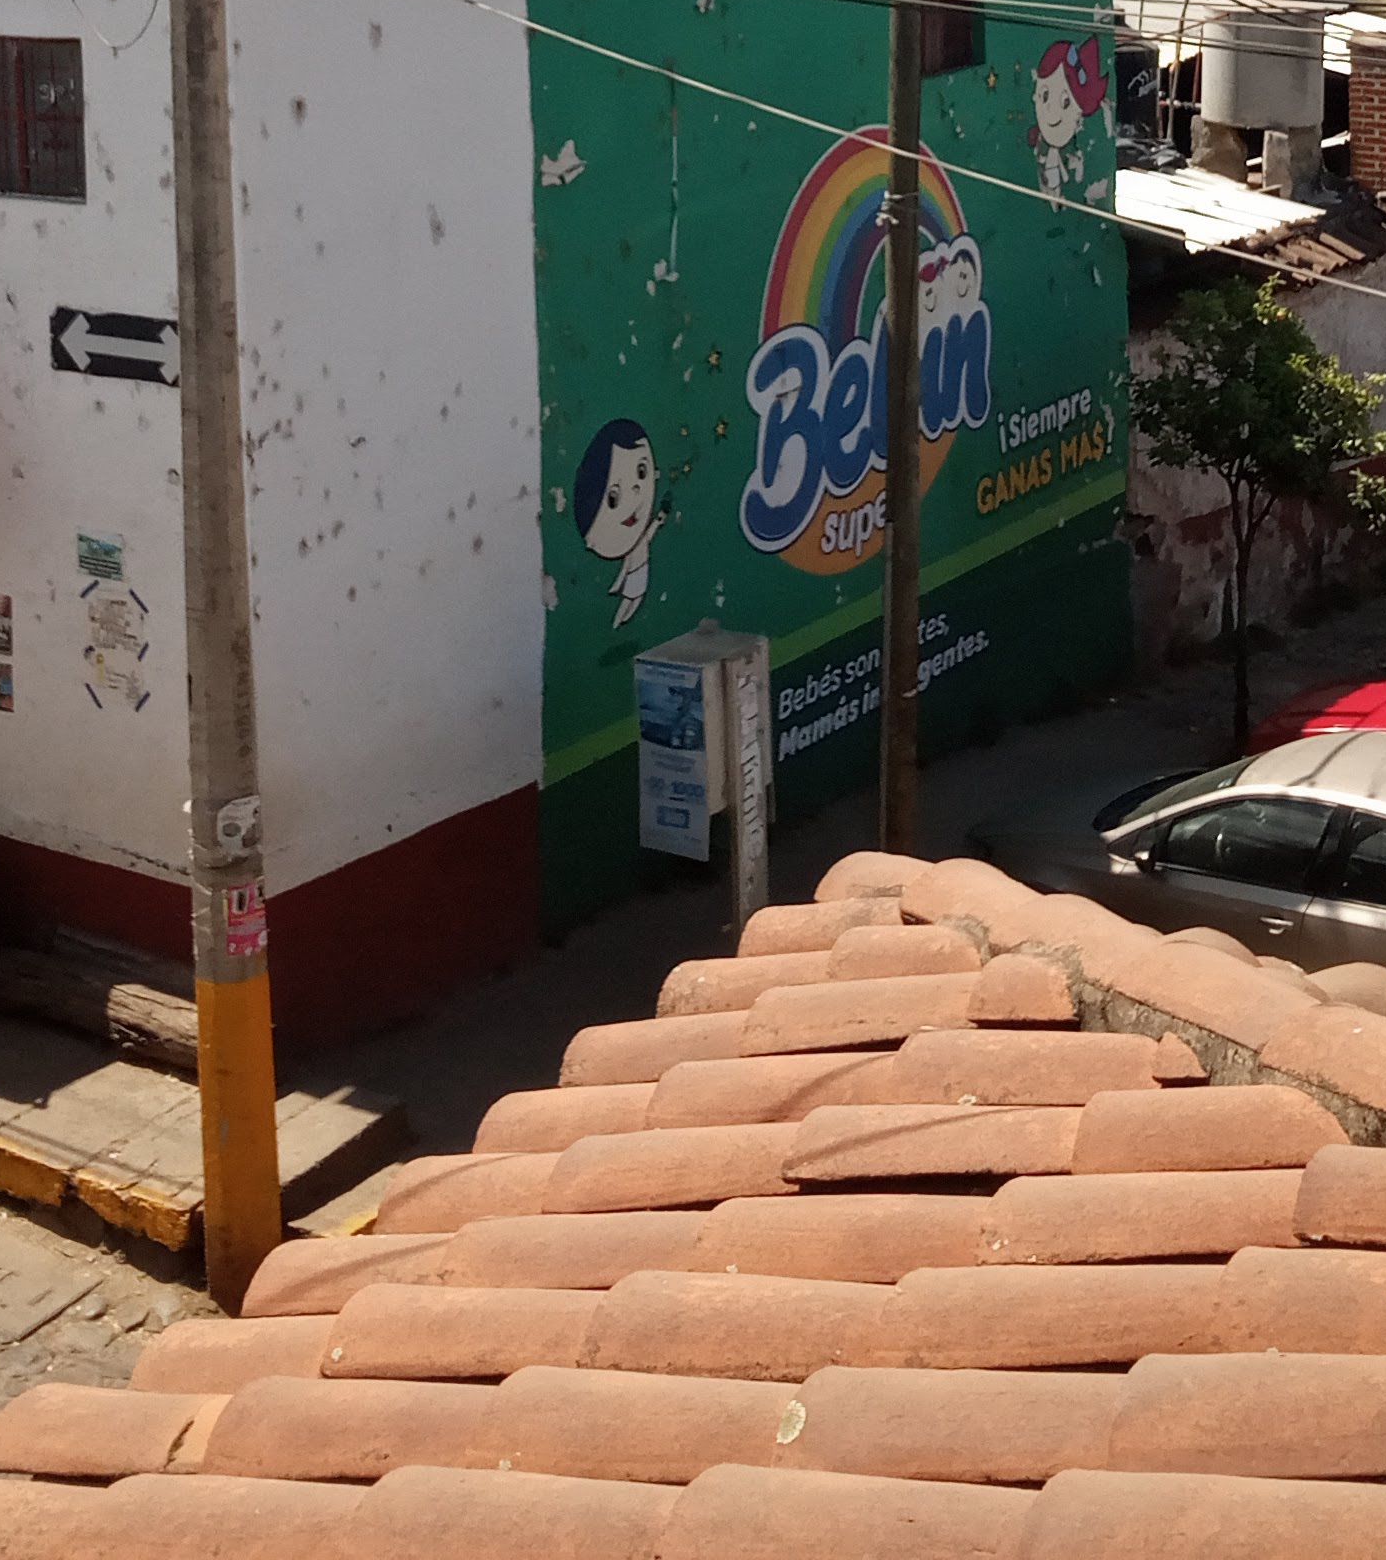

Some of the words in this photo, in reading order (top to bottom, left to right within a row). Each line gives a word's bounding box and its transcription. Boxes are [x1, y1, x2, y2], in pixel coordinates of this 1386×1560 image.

[976, 447, 1053, 515] GANAS
[820, 490, 887, 557] supe
[778, 663, 843, 720] Bebés
[777, 695, 861, 762] Mamás
